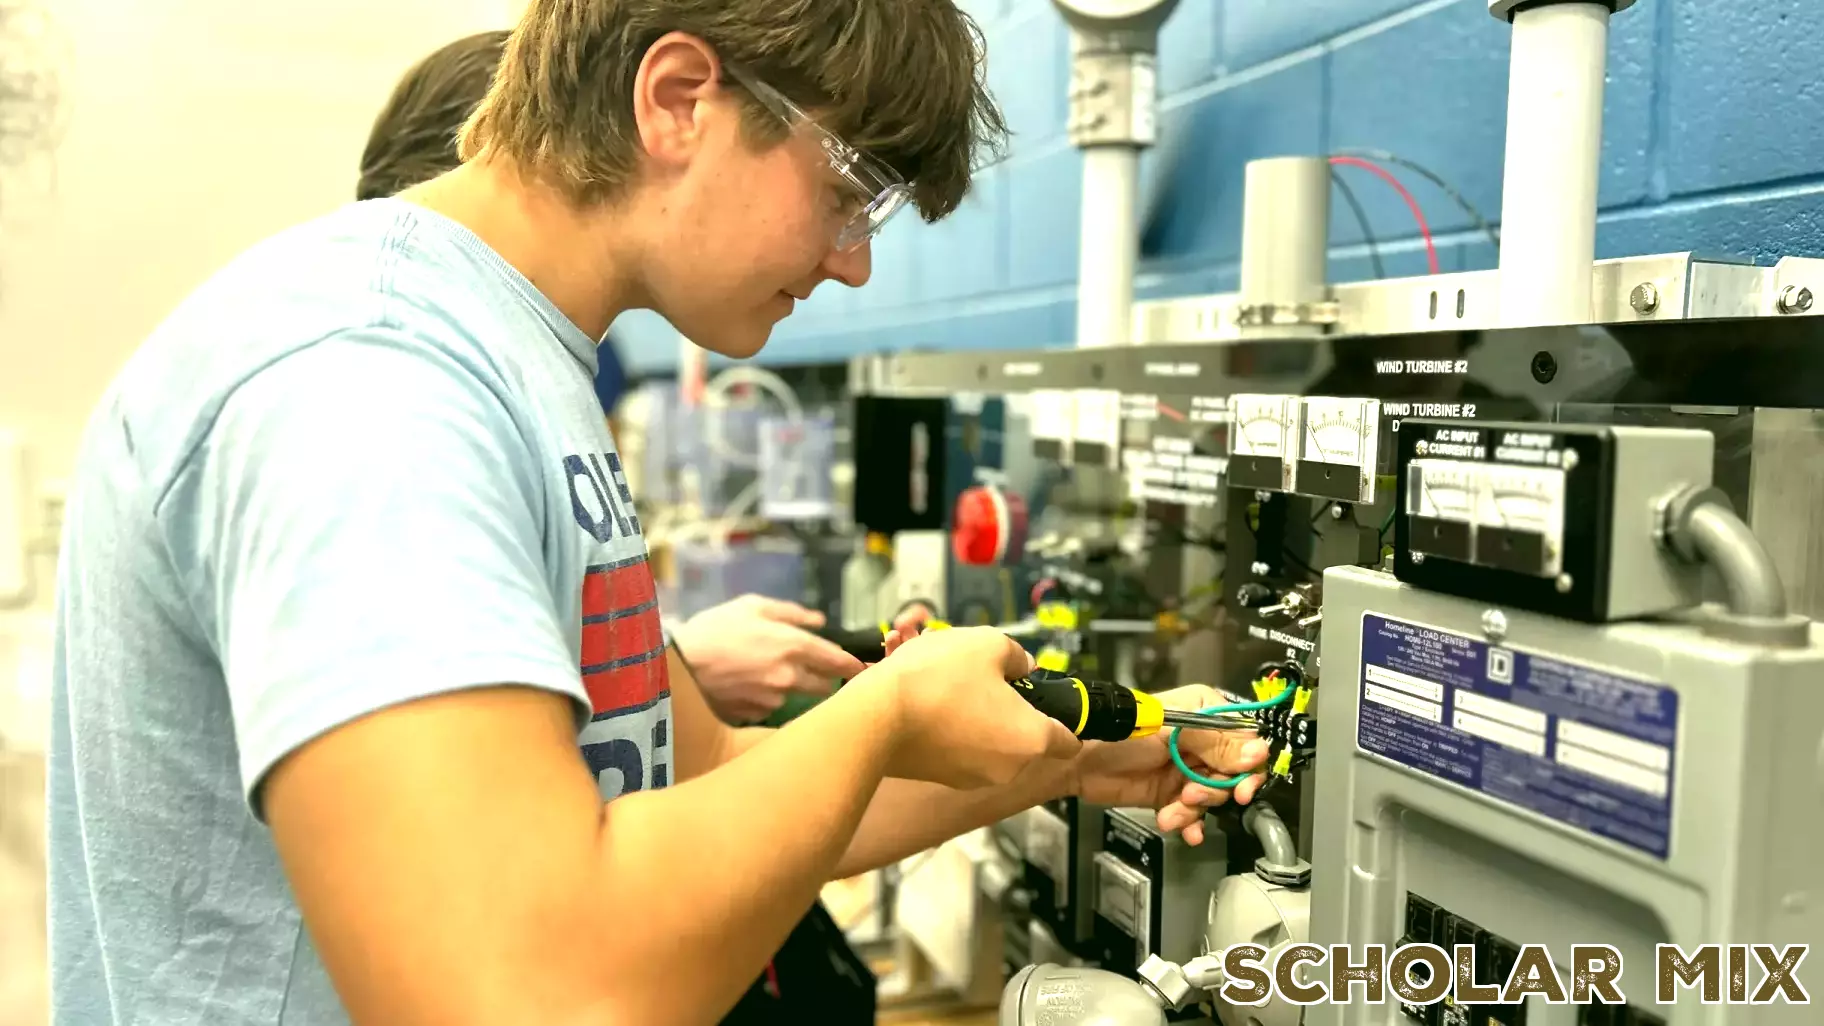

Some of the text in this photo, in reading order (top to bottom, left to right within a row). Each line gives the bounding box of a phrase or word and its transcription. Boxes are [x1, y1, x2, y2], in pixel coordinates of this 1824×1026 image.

[1377, 361, 1468, 373] WIND TURBINE #2
[1384, 403, 1476, 417] WIND TURBINE #2
[1436, 430, 1480, 443] AC INPUT
[1429, 442, 1472, 457] CURRENT
[1269, 629, 1316, 653] DISCONNECT
[1385, 621, 1470, 649] Homeline LOAD CENTER
